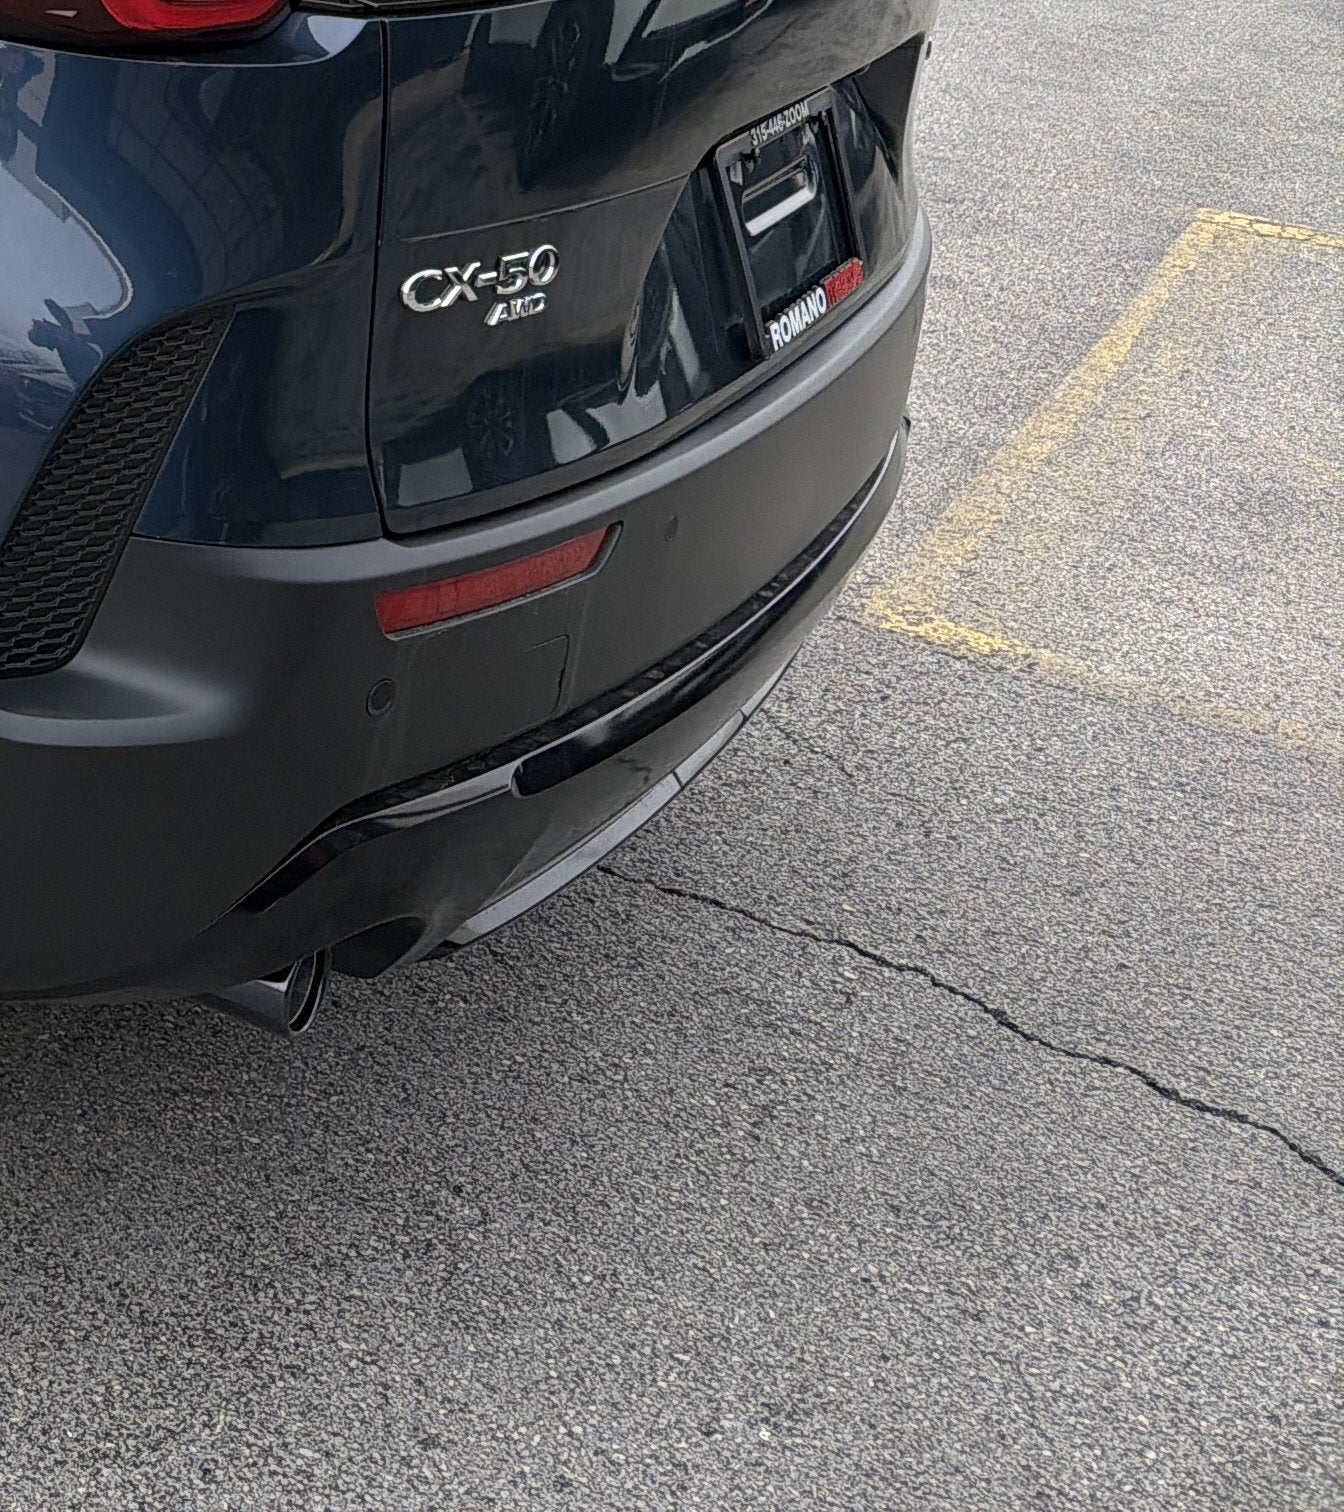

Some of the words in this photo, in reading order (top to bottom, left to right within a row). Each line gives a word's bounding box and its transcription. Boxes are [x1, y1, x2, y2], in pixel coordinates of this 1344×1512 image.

[400, 244, 561, 313] CX-50
[484, 292, 548, 326] AWD
[769, 286, 827, 352] ROMANO
